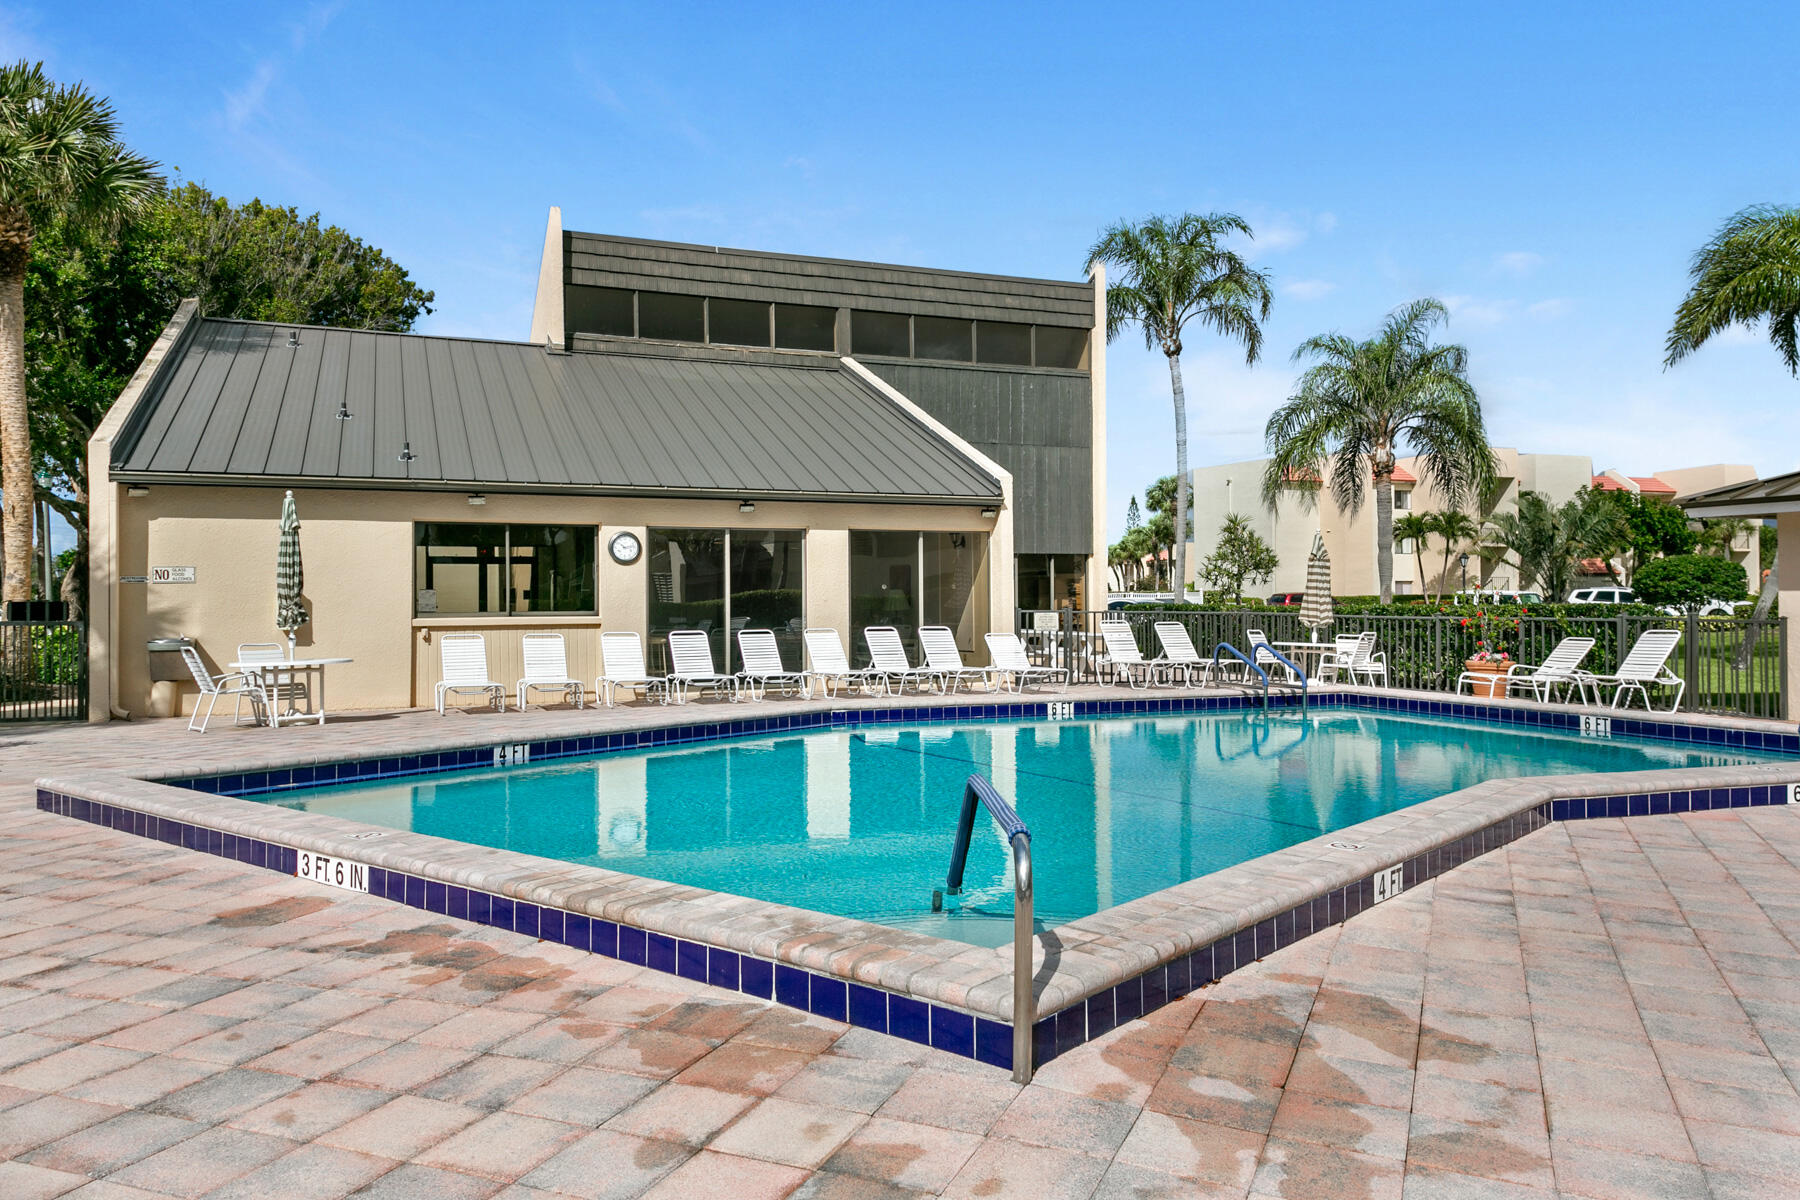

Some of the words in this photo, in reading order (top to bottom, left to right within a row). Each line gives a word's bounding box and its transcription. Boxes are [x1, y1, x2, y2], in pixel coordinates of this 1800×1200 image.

[154, 569, 170, 581] NO
[1051, 702, 1057, 716] 6
[1061, 701, 1073, 718] FT
[1584, 716, 1591, 731] 6
[1595, 717, 1609, 735] FT
[499, 744, 507, 763] 4
[512, 743, 528, 765] FT
[302, 853, 310, 877] 3
[335, 861, 344, 886] 6
[1378, 873, 1386, 900] 4
